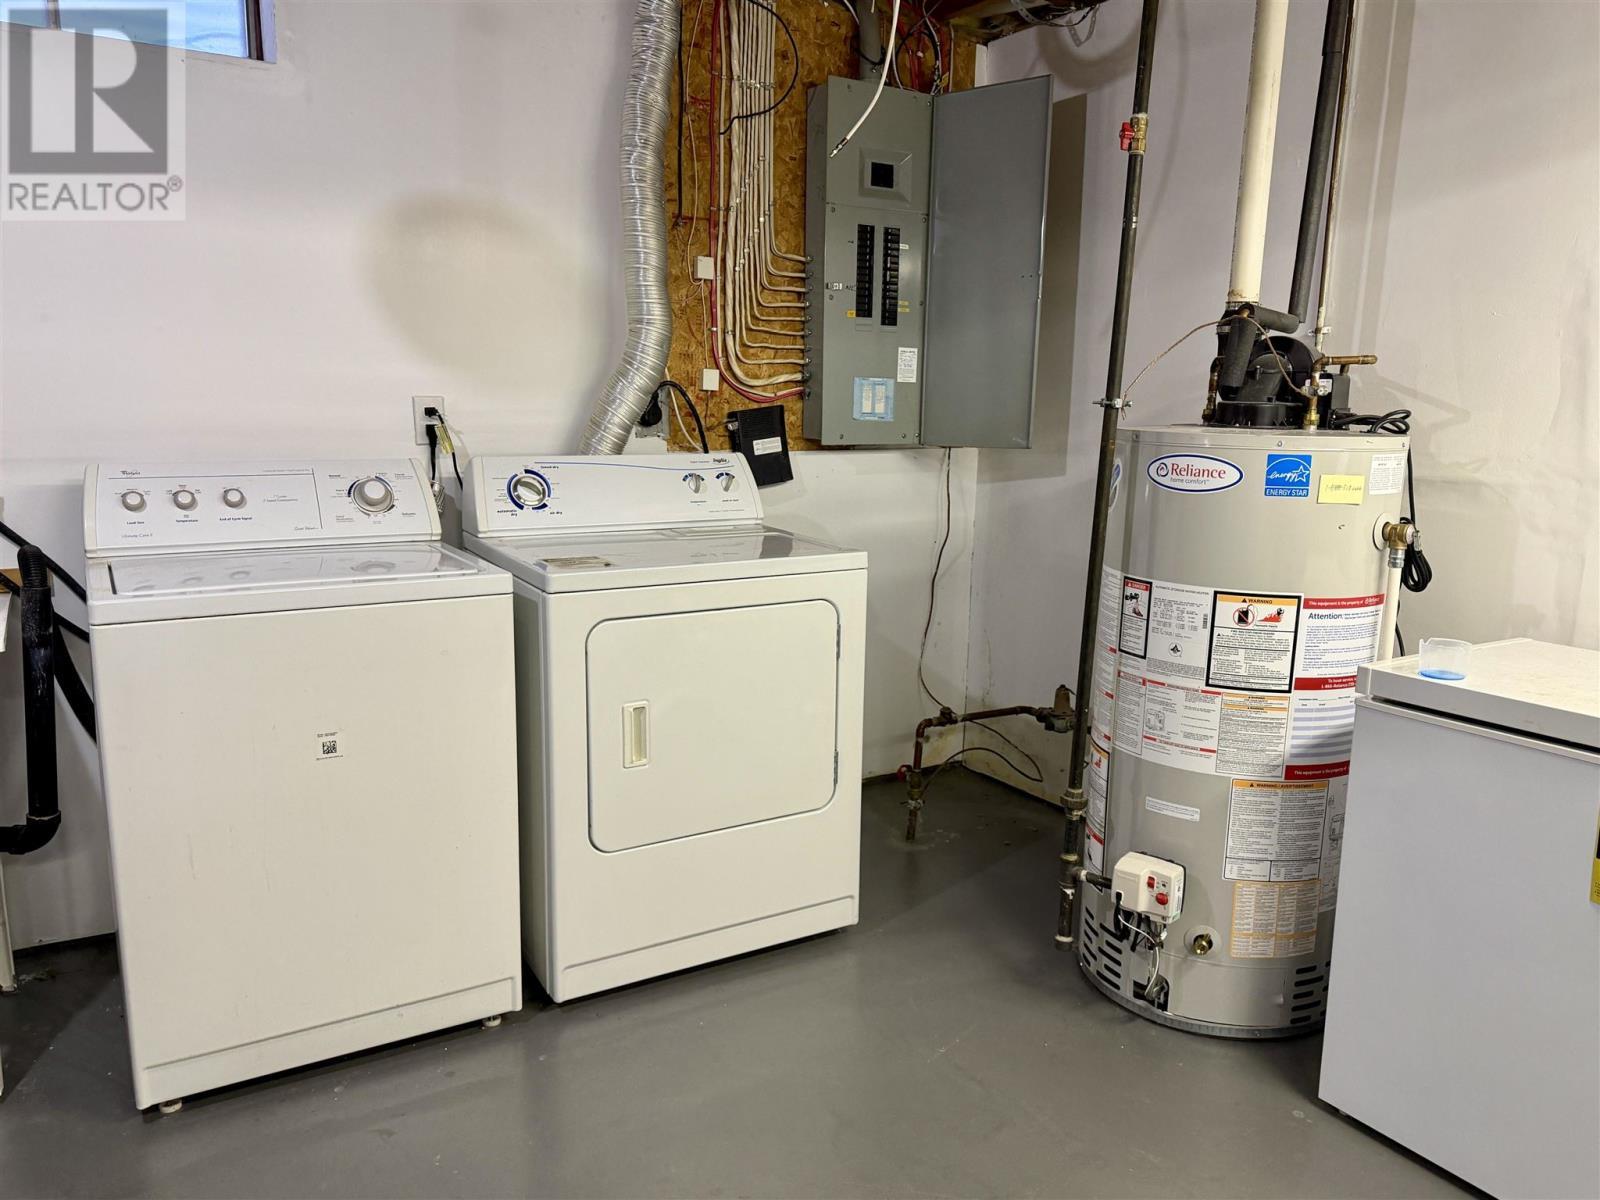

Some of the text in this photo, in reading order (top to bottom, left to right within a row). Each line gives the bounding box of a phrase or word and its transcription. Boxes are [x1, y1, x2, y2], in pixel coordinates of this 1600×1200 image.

[1170, 463, 1226, 479] Reliance
[1266, 488, 1308, 497] ENERGY STAR
